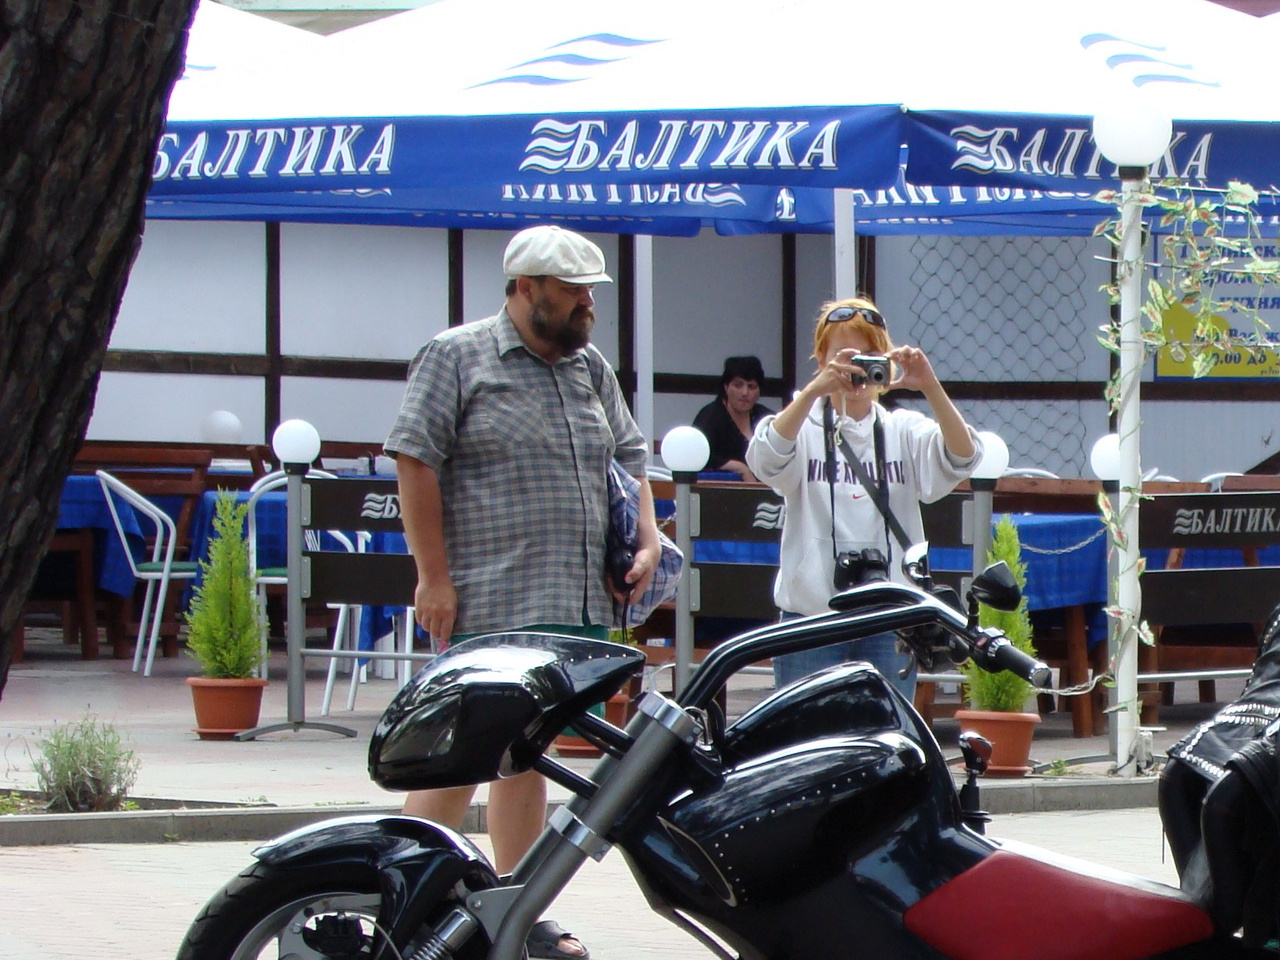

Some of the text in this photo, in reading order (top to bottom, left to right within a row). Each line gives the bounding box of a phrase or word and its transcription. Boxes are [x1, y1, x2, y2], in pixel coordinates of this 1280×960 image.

[152, 124, 396, 181] БАЛТИКА
[563, 119, 842, 172] БАЛТИКА
[992, 126, 1213, 180] БАЛТКА
